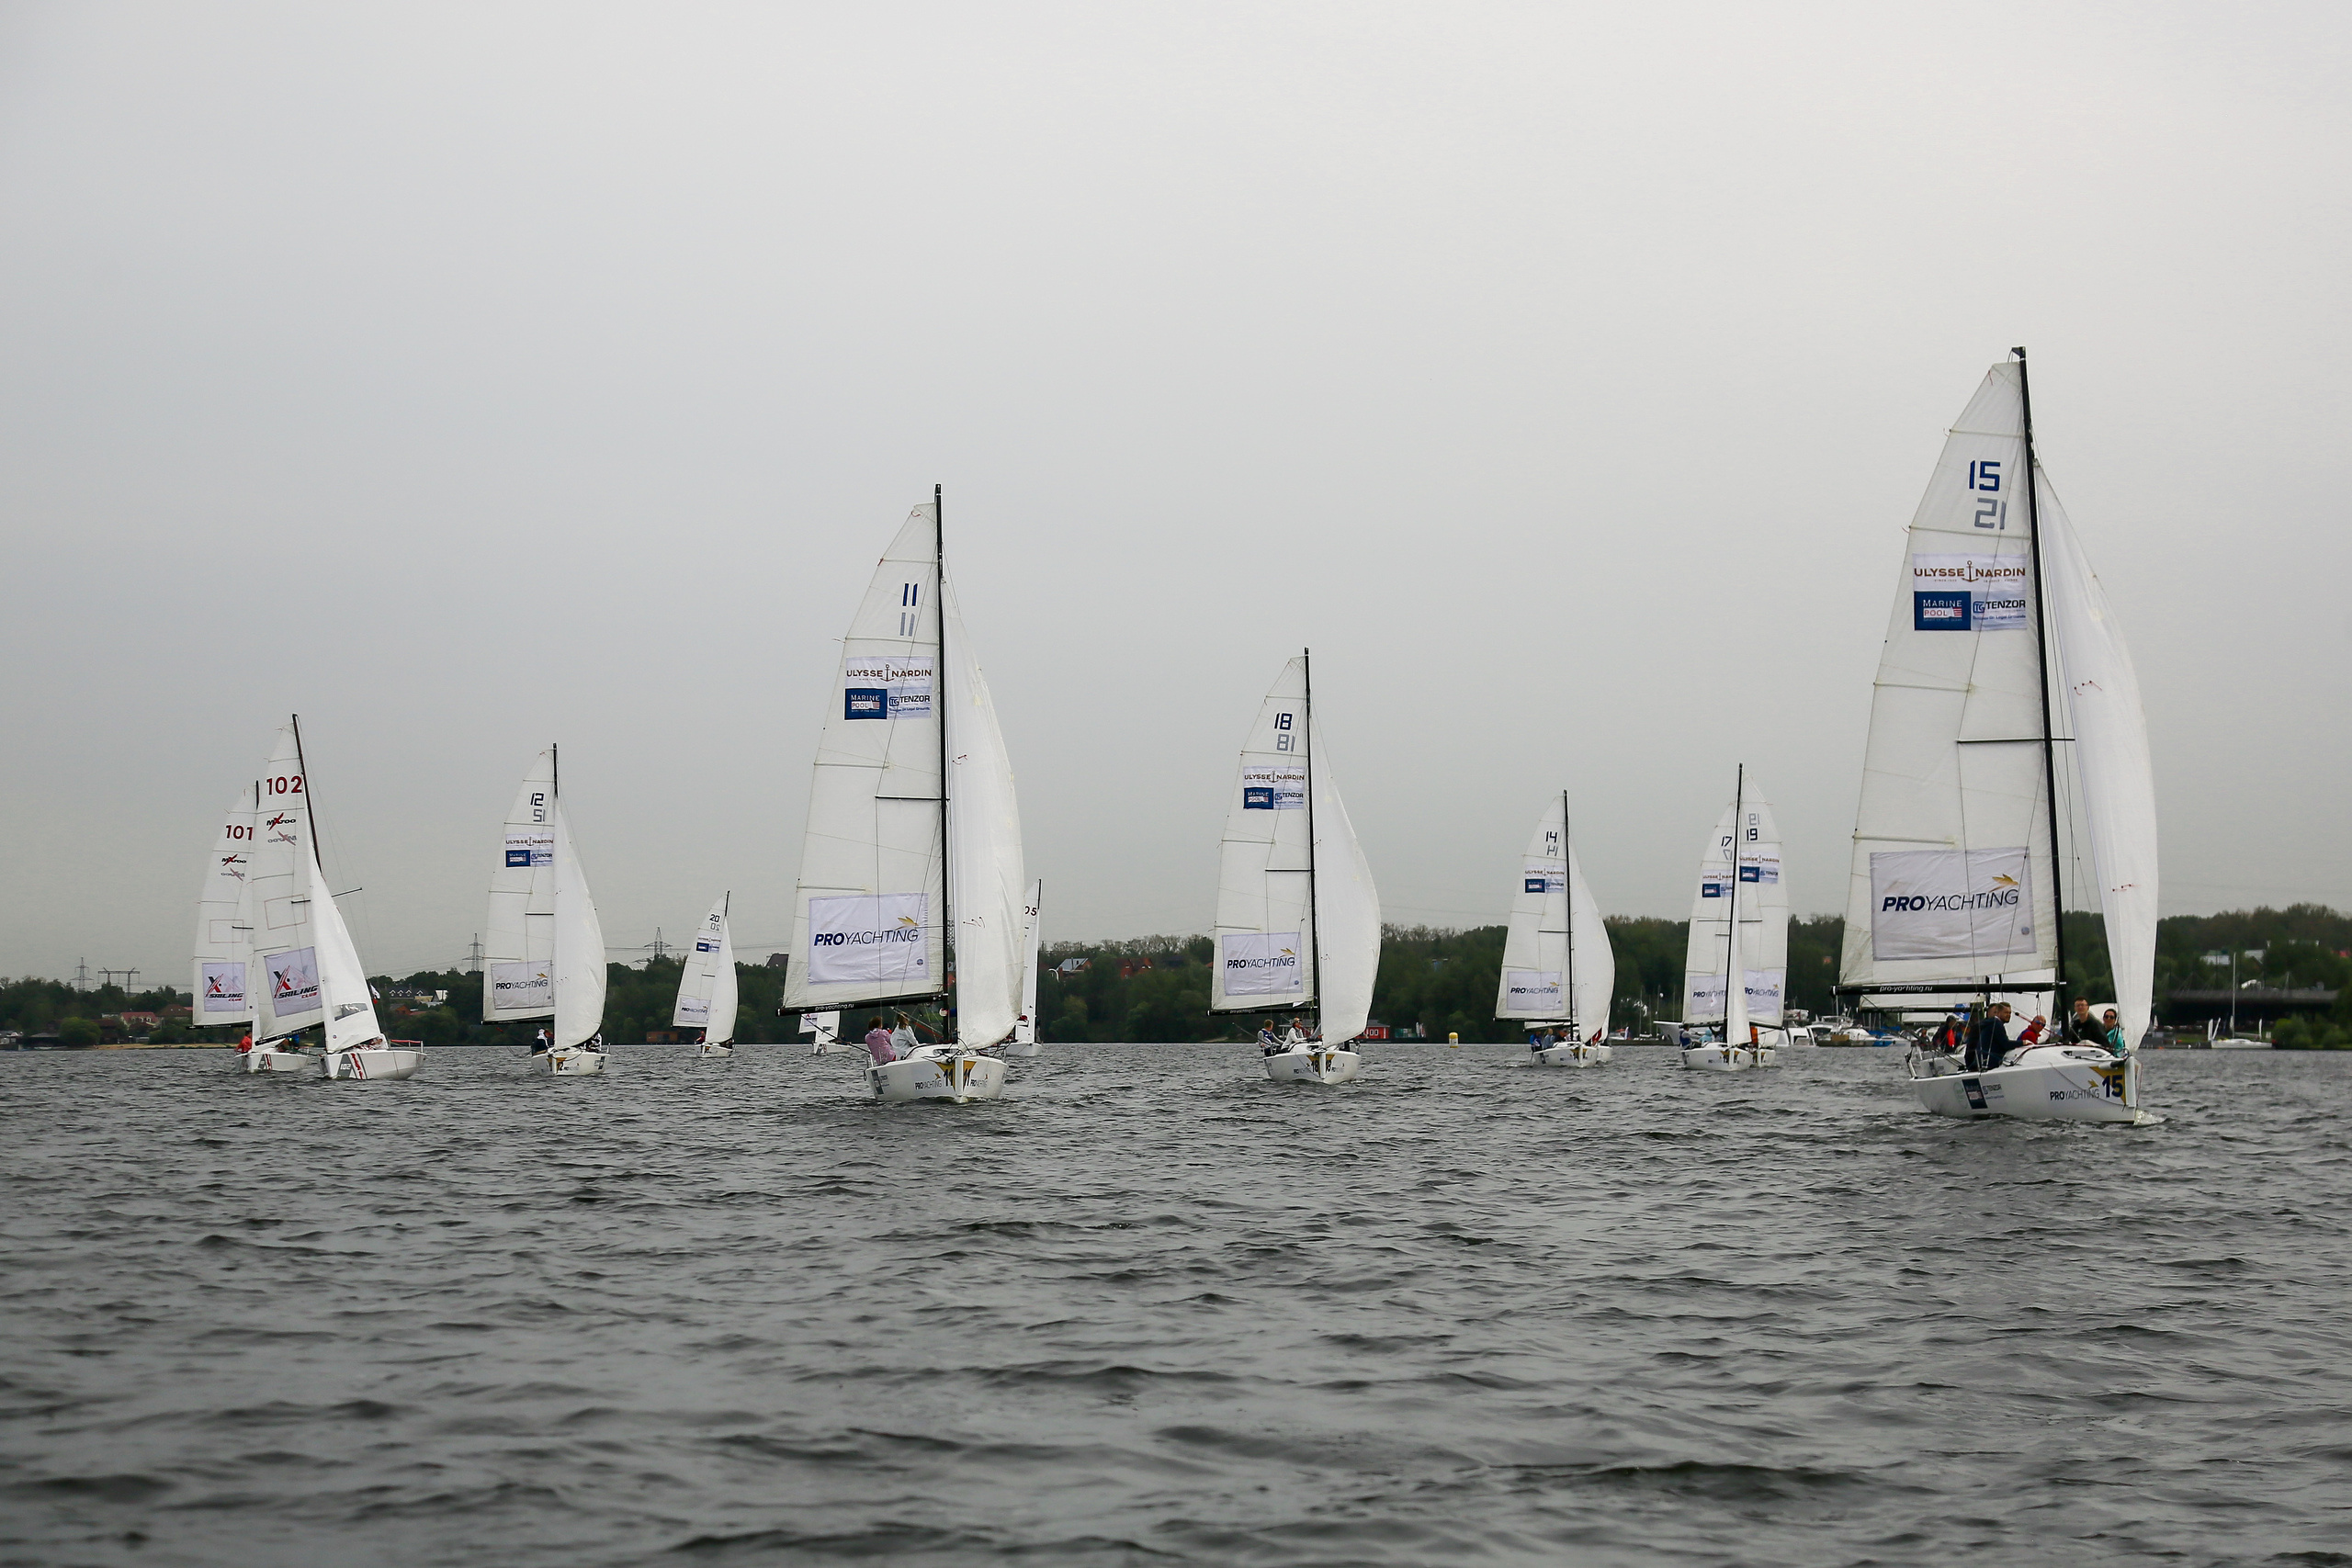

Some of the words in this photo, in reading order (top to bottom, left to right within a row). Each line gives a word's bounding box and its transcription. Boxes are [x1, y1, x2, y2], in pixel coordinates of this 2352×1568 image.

[1969, 460, 2001, 491] 15
[1914, 568, 1965, 577] ULYSSE
[1975, 568, 2026, 578] NARDIN
[902, 583, 918, 606] 11
[1923, 599, 1962, 607] MARINE
[1985, 600, 2026, 609] TENZOR
[1924, 608, 1948, 616] POOL
[1274, 713, 1293, 730] 18
[266, 776, 302, 795] 102
[530, 793, 544, 807] 12
[225, 825, 254, 840] 101
[1545, 831, 1558, 843] 14
[1747, 828, 1758, 840] 19
[1882, 888, 2018, 912] PROYACHTING
[709, 914, 720, 922] 20
[814, 928, 919, 946] PROYACHTING
[1227, 956, 1295, 969] PROYACHTING
[277, 985, 319, 999] SAILING
[2102, 1075, 2123, 1098] 15
[2050, 1089, 2099, 1101] PROYACHTING
